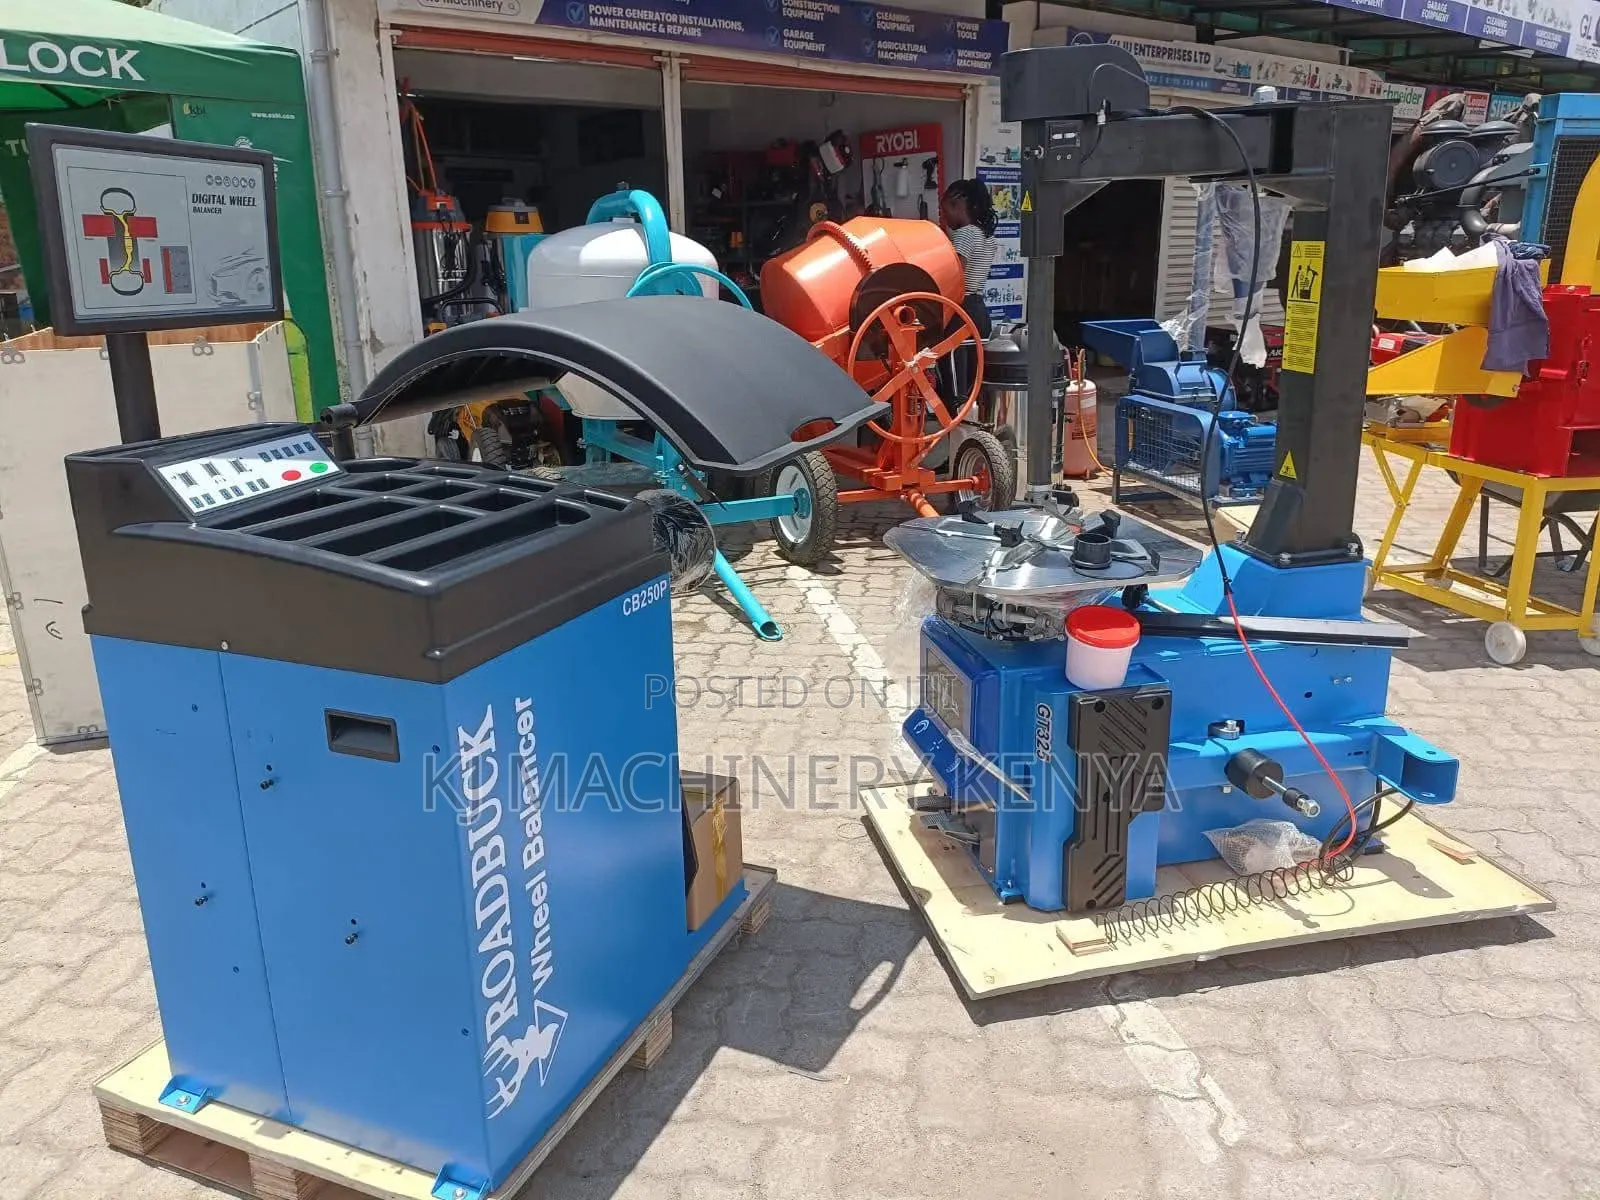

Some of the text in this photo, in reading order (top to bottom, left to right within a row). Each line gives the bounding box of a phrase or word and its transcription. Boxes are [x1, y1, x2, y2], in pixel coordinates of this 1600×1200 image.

[782, 0, 840, 14] CONSTRUCTION
[588, 4, 745, 33] POWER GENERATOR INSTALLATIONS,
[782, 8, 825, 21] EQUIPMENT
[876, 12, 911, 23] CLEANING
[589, 16, 701, 37] MAINTENANCE & REPAIRS
[876, 21, 915, 33] EQUIPMENT
[956, 22, 980, 31] POWER
[783, 28, 815, 40] GARAGE
[957, 30, 978, 40] TOOLS
[783, 39, 826, 52] EQUIPMENT
[877, 40, 928, 53] AGRICULTURAL
[0, 38, 146, 81] LOCK
[877, 51, 918, 62] MACHINERY
[957, 49, 992, 60] WORKSHOP
[1134, 43, 1193, 63] ENTERPRISES
[1193, 51, 1211, 65] LTD
[957, 59, 993, 69] MACHINERY
[1384, 84, 1422, 105] hneider
[875, 129, 918, 153] RYOBI
[191, 193, 257, 207] DIGITAL WHEEL
[192, 206, 222, 215] BALANCER
[622, 579, 668, 617] CB250P
[1035, 702, 1053, 764] GT325
[514, 696, 555, 994] Wheel Balancer
[458, 703, 520, 1045] ROADBUCK
